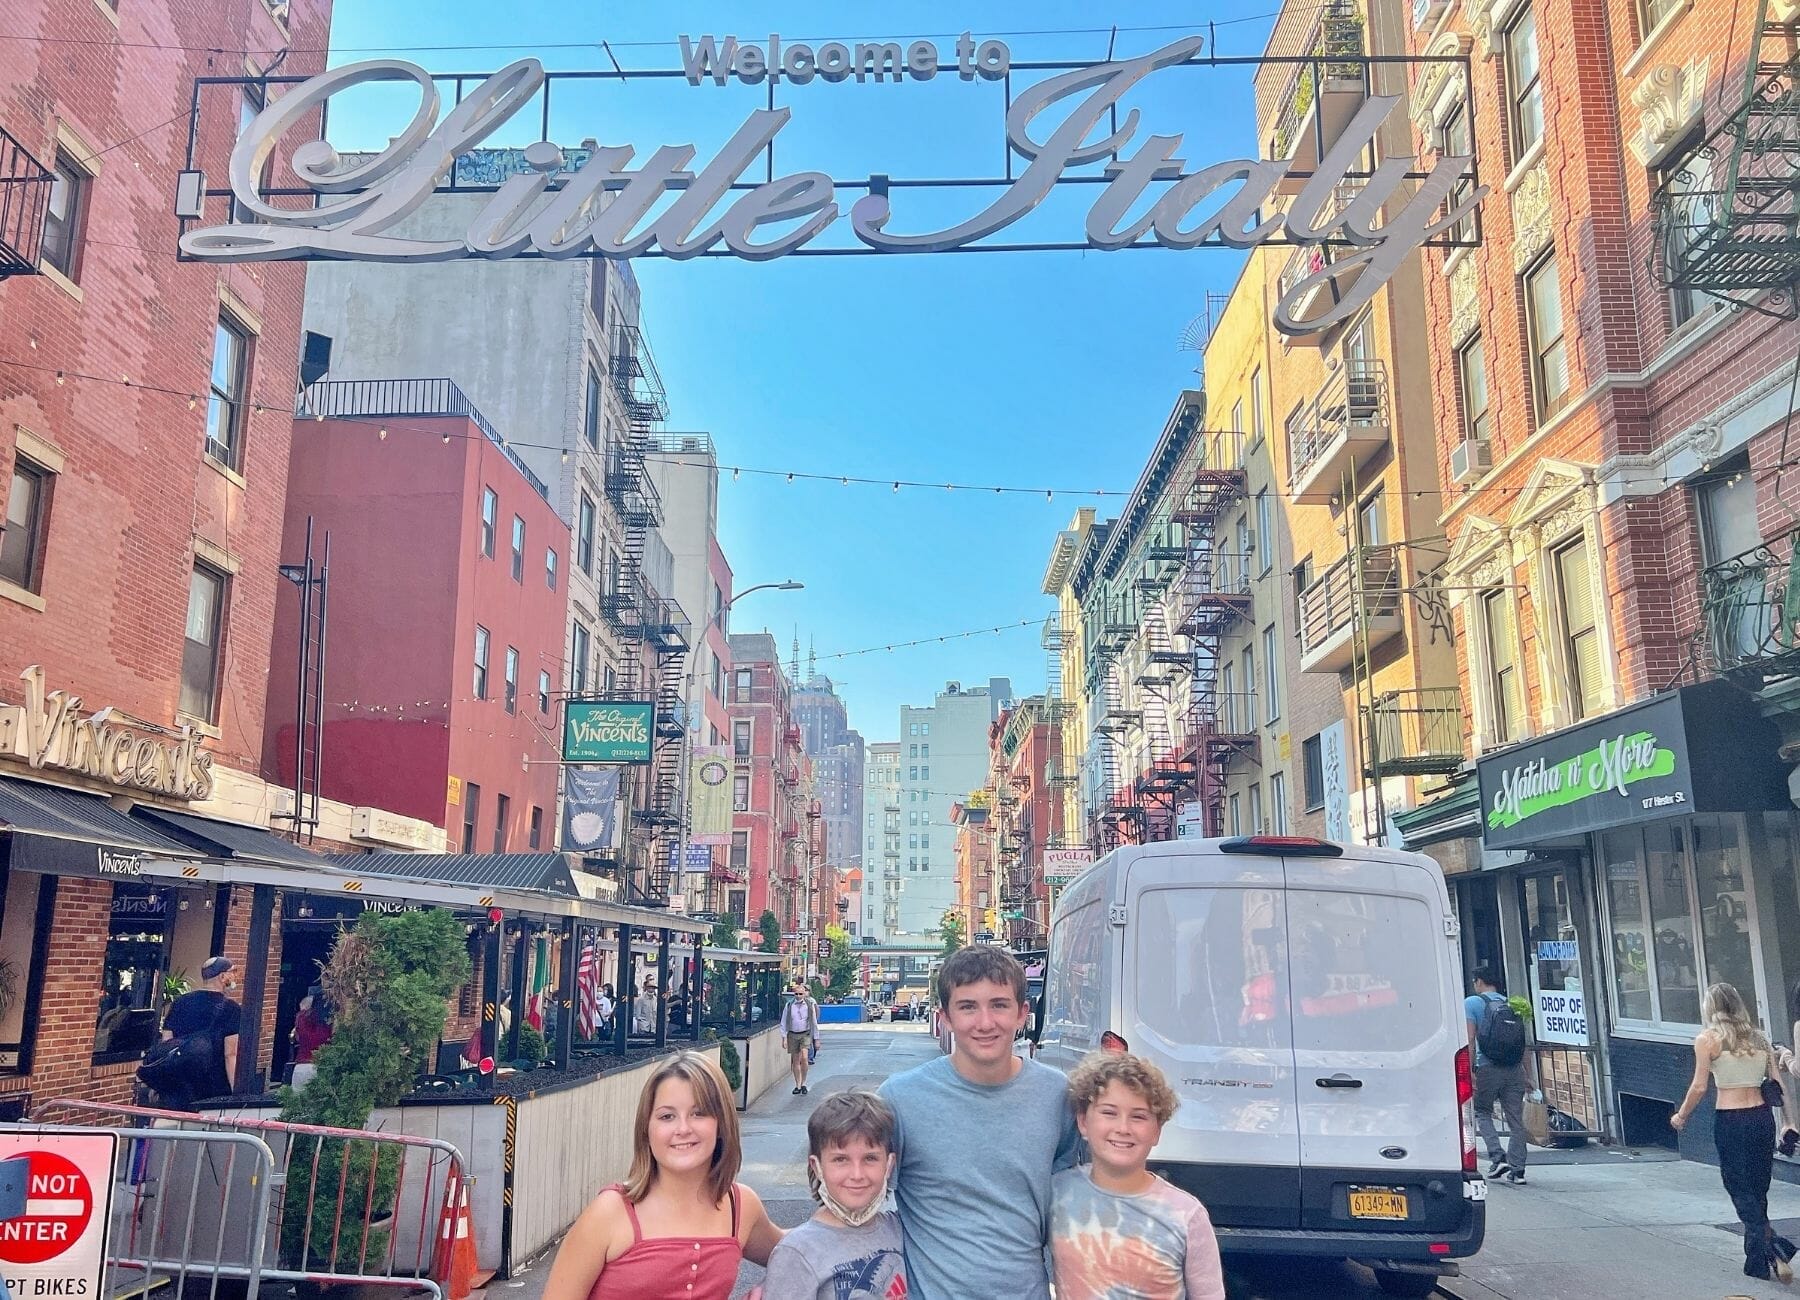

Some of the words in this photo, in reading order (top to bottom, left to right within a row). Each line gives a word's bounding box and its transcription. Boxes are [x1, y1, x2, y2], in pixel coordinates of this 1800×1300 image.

[678, 34, 938, 86] Welcome
[956, 31, 1010, 81] to
[179, 57, 838, 262] Little
[851, 36, 1489, 335] Italy
[588, 709, 607, 722] The
[607, 709, 646, 728] Original
[1494, 757, 1563, 820] Matcha
[1588, 734, 1658, 796] More
[1048, 852, 1092, 863] PUGLIA
[1541, 997, 1566, 1013] DROP
[1546, 1016, 1587, 1035] SERVICE
[1181, 1078, 1247, 1088] TRANSIT
[32, 1174, 80, 1194] NOT
[1354, 1195, 1384, 1212] 61349
[34, 1278, 88, 1295] BIKES
